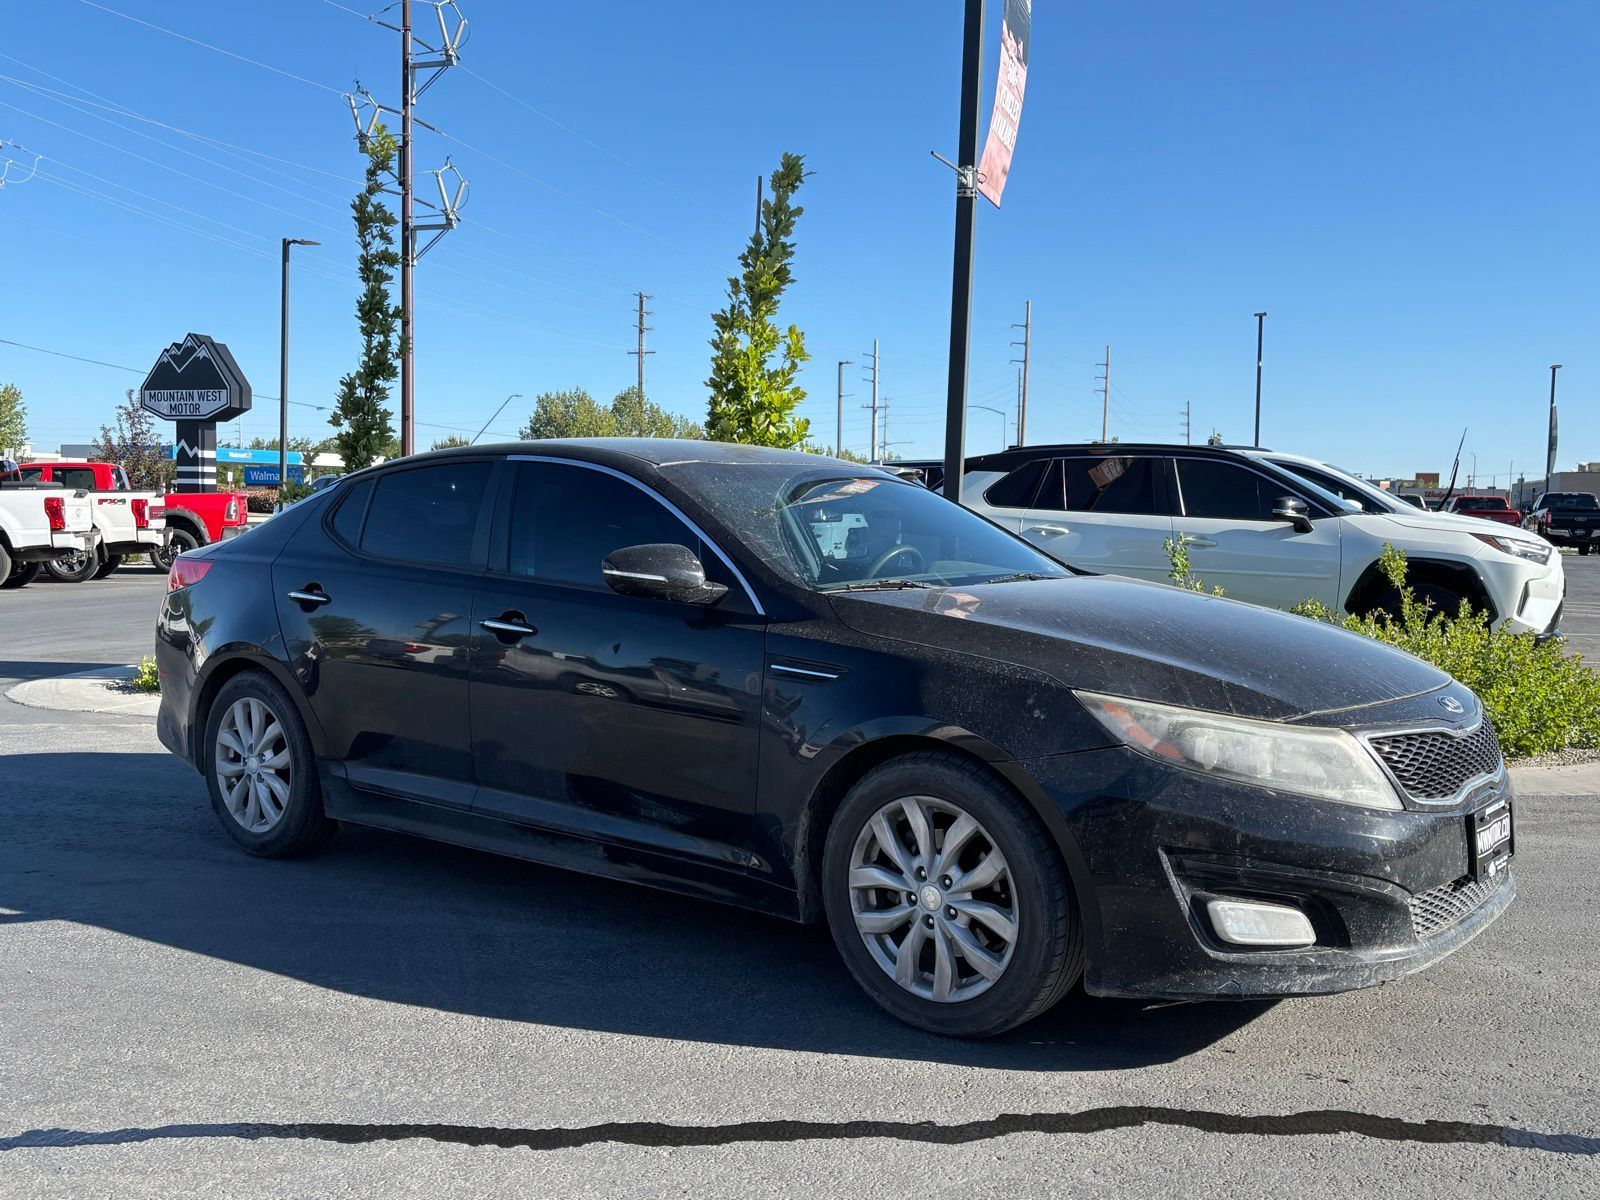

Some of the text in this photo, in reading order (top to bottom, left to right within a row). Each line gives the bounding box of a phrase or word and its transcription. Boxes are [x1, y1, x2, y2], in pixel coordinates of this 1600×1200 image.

[149, 391, 222, 402] MOUNTAIN WEST
[169, 403, 201, 414] MOTOR
[250, 470, 280, 481] Walma
